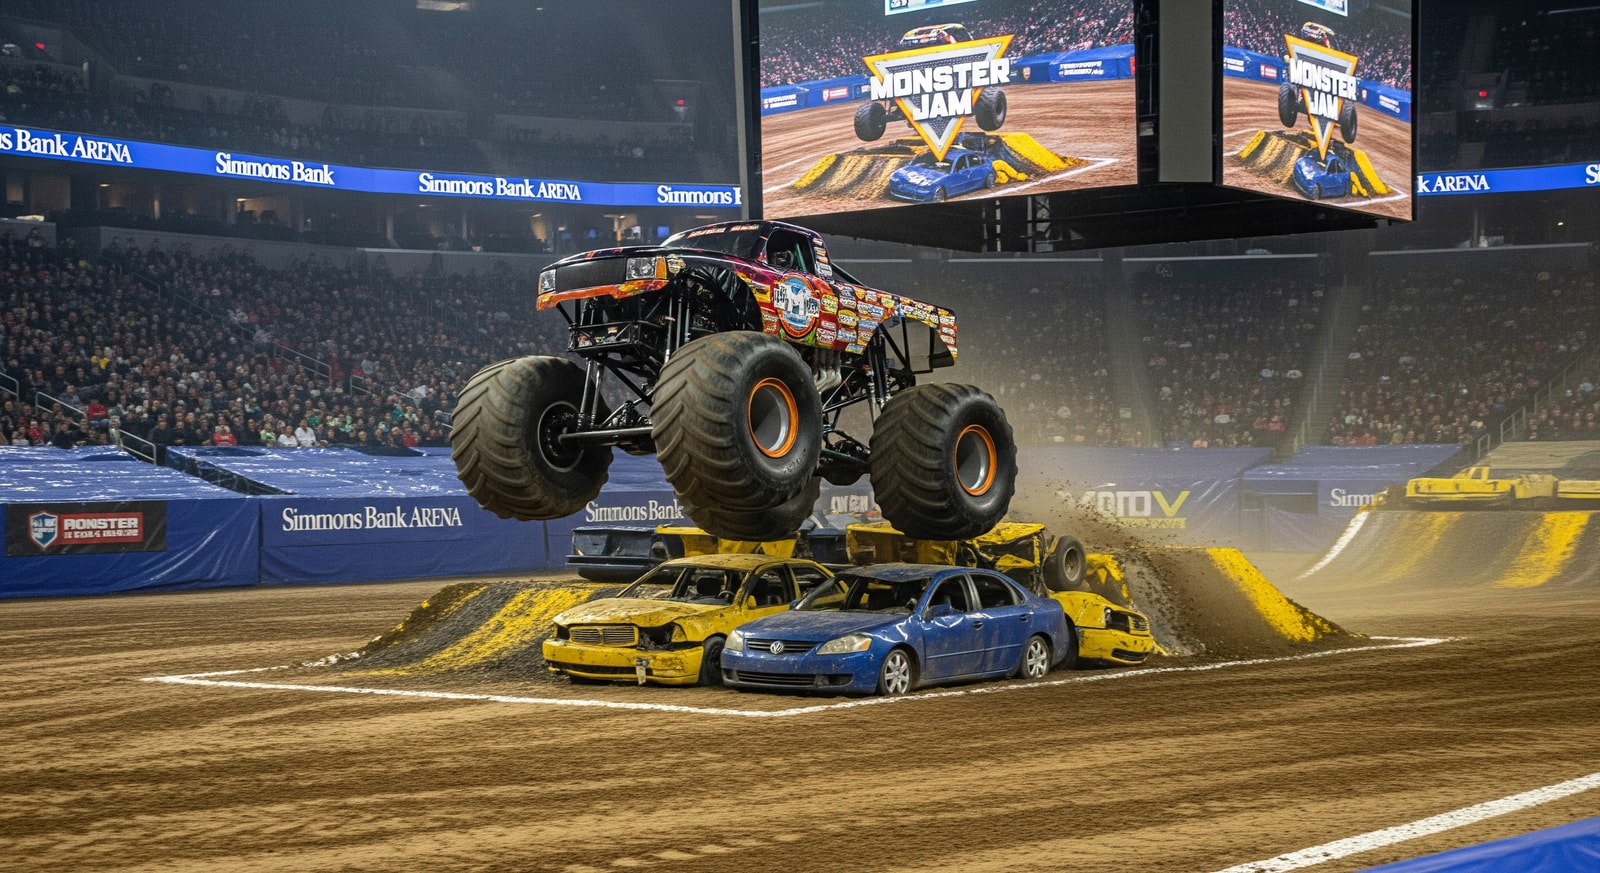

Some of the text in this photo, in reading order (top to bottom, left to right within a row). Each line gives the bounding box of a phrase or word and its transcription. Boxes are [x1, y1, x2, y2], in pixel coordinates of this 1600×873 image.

[870, 58, 1010, 100] MONSTER
[1290, 58, 1357, 101] MONSTER
[912, 89, 972, 121] JAM
[1310, 90, 1339, 120] JAM
[14, 128, 69, 156] Bank
[70, 136, 133, 163] ARENA
[215, 152, 335, 185] Simmons Bank
[1432, 174, 1490, 192] ARENA
[418, 172, 582, 200] Simmons Bank ARENA
[657, 185, 733, 204] Simmons
[282, 506, 463, 531] Simmons Bank ARENA
[585, 498, 685, 522] Simmons Bank
